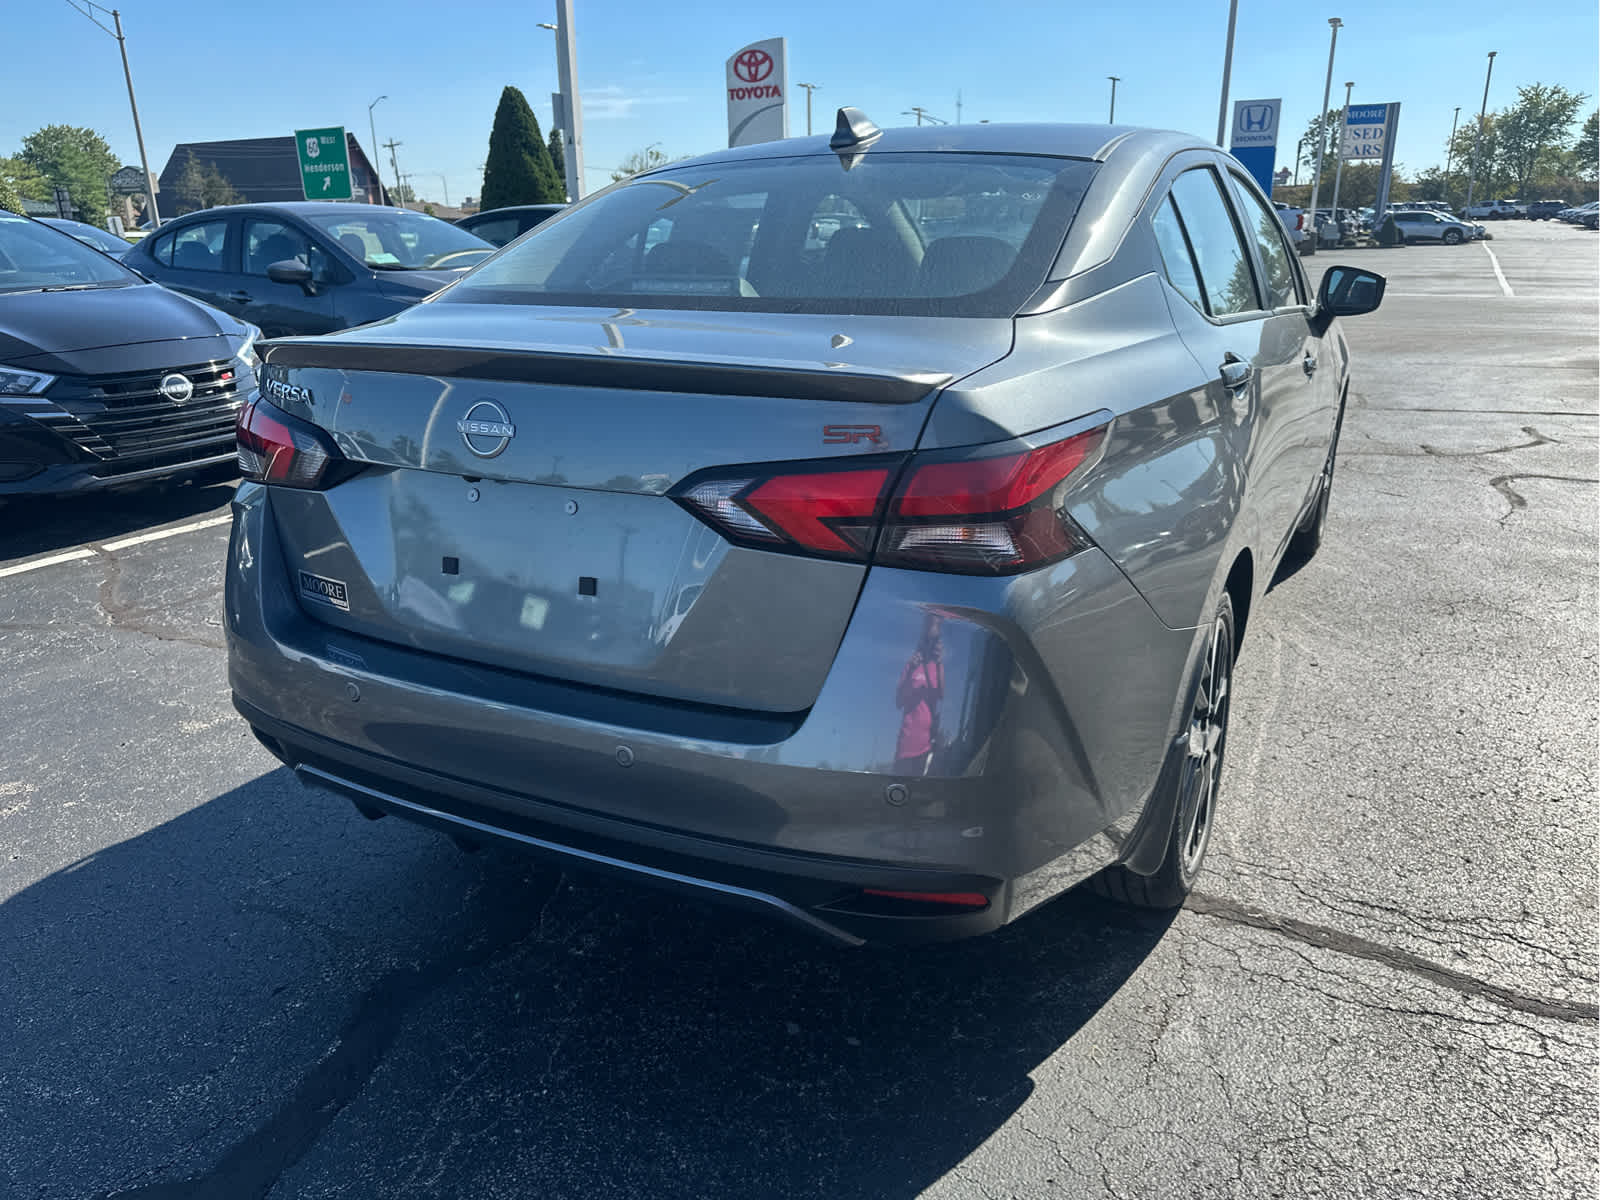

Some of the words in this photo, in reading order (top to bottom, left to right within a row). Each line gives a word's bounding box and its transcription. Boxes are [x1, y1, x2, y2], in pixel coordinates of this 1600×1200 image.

[727, 85, 782, 101] TOYOTA
[1346, 109, 1385, 119] MOORE
[303, 162, 345, 174] Henderson
[265, 378, 313, 410] VERSA
[456, 421, 514, 436] NISSAN
[823, 424, 882, 444] SR
[302, 575, 345, 600] MOORE
